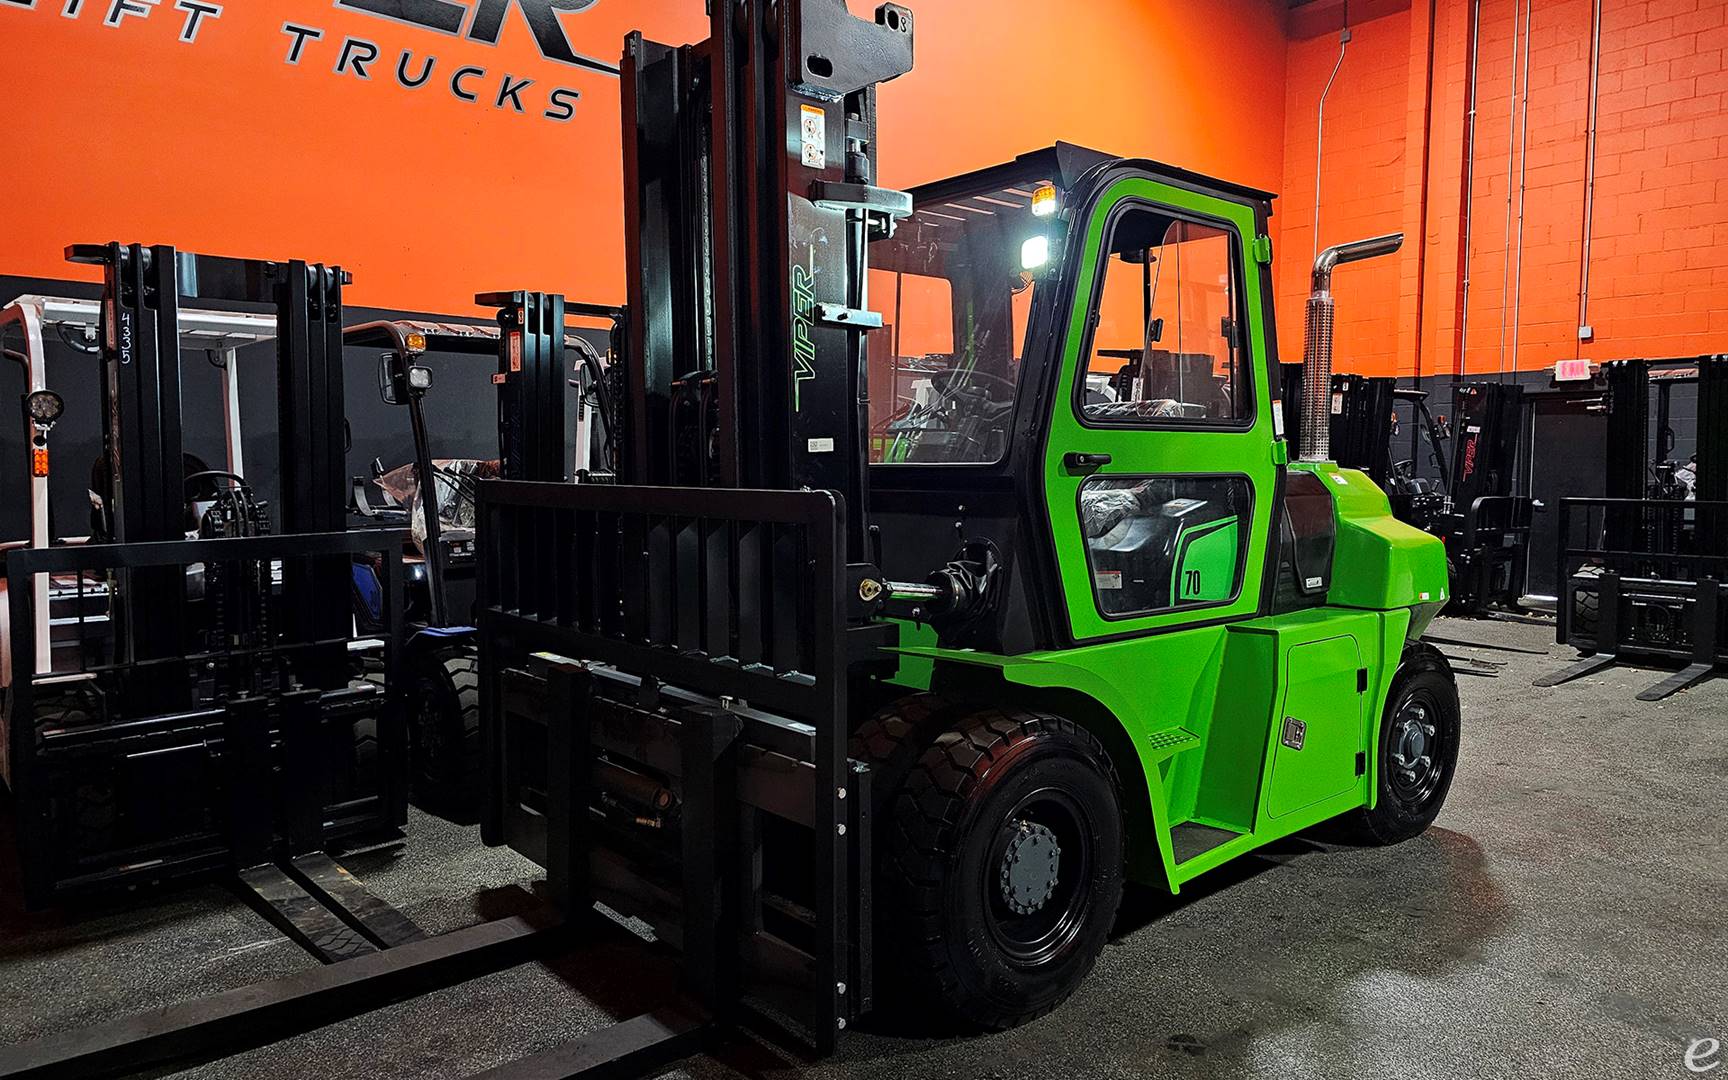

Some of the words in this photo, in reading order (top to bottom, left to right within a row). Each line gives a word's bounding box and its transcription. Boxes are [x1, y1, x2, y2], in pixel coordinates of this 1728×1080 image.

[0, 0, 223, 44] FT
[281, 21, 581, 122] TRUCKS
[121, 312, 132, 364] 4335
[793, 246, 816, 410] VIPER
[1185, 569, 1201, 596] 70
